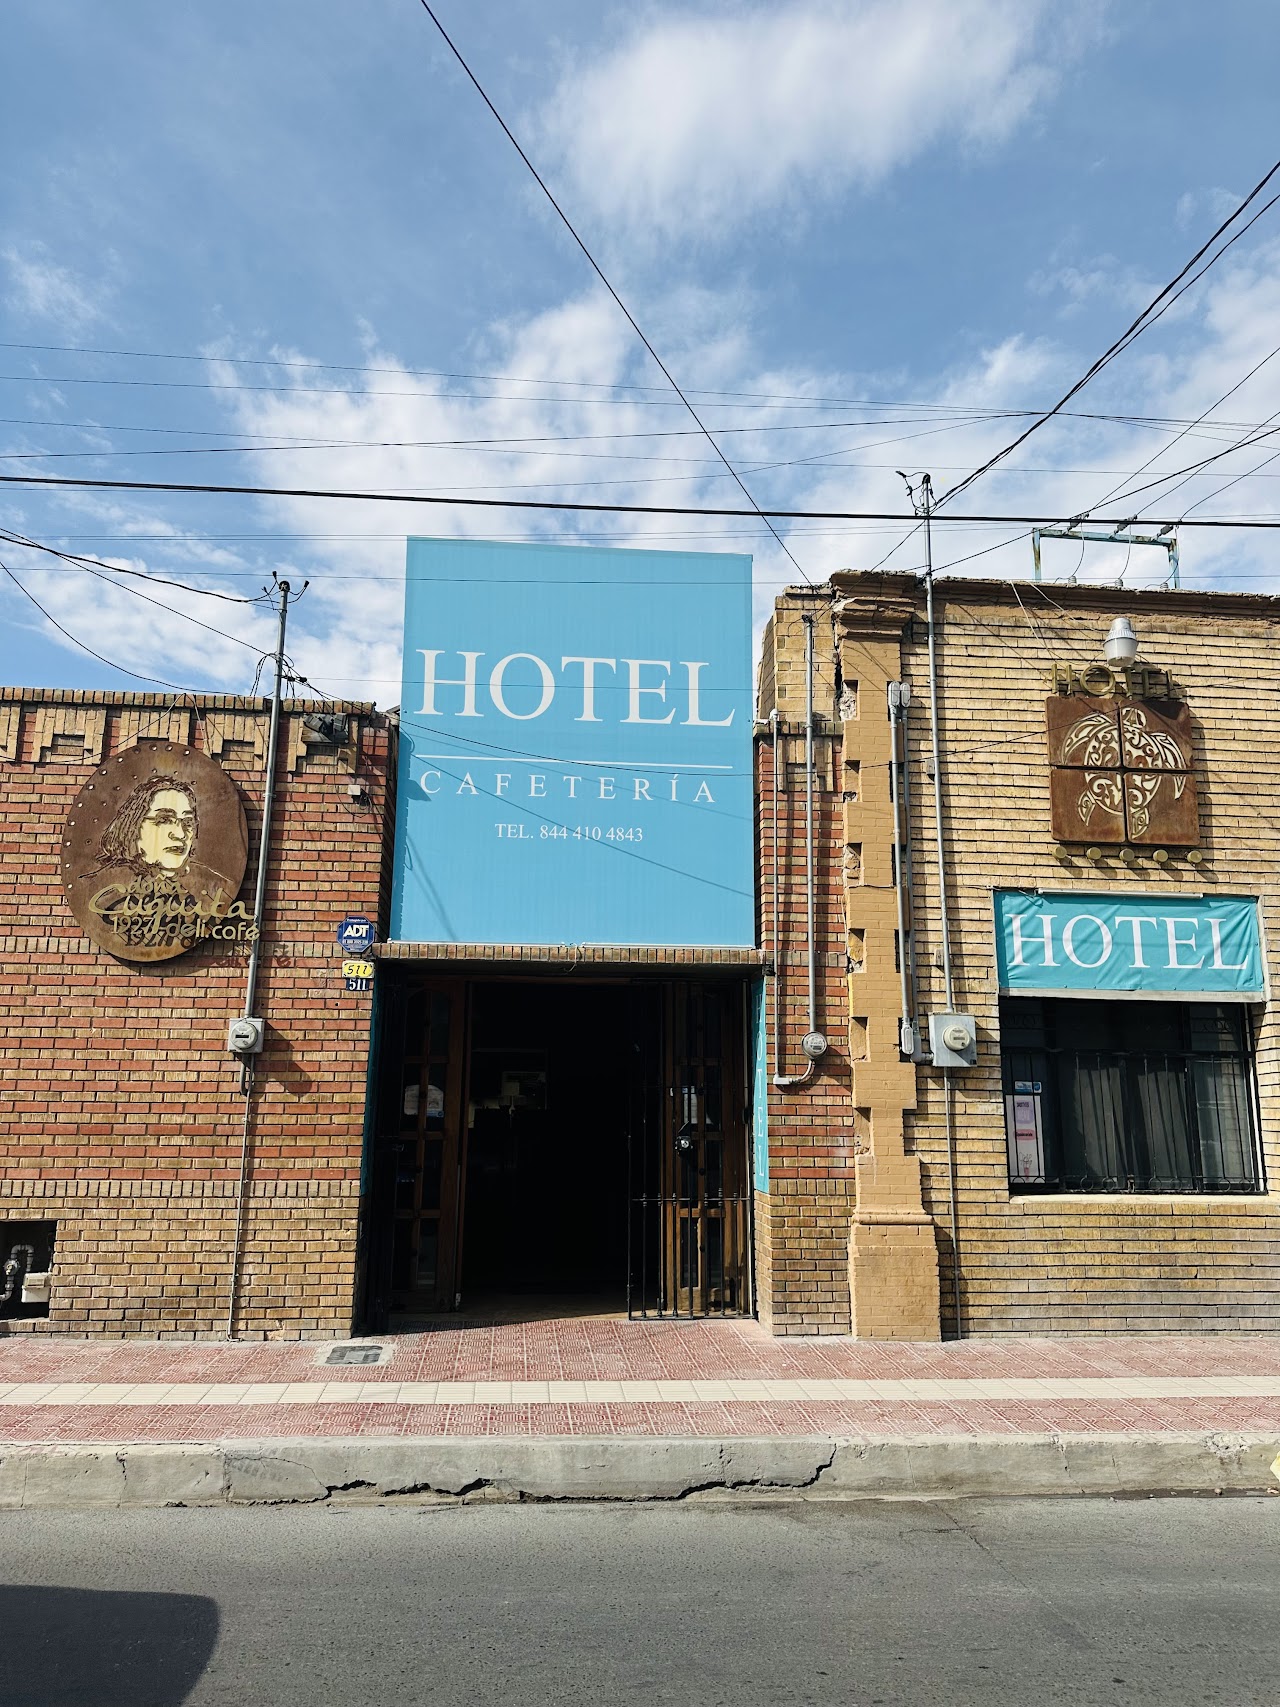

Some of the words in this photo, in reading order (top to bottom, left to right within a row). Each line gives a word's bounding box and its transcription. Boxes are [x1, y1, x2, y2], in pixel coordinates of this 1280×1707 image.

[413, 648, 736, 727] HOTEL
[1051, 664, 1187, 700] HOTEL
[420, 770, 716, 803] CAFETERÍA
[494, 823, 534, 840] TEL.
[540, 824, 568, 840] 844
[573, 825, 601, 842] 410
[605, 826, 643, 843] 4843
[126, 873, 188, 894] doña
[111, 916, 154, 935] 1927
[343, 924, 369, 938] ADT
[1005, 913, 1249, 970] HOTEL
[347, 964, 368, 975] 511
[349, 978, 366, 991] 511
[756, 994, 764, 1177] HOTEL
